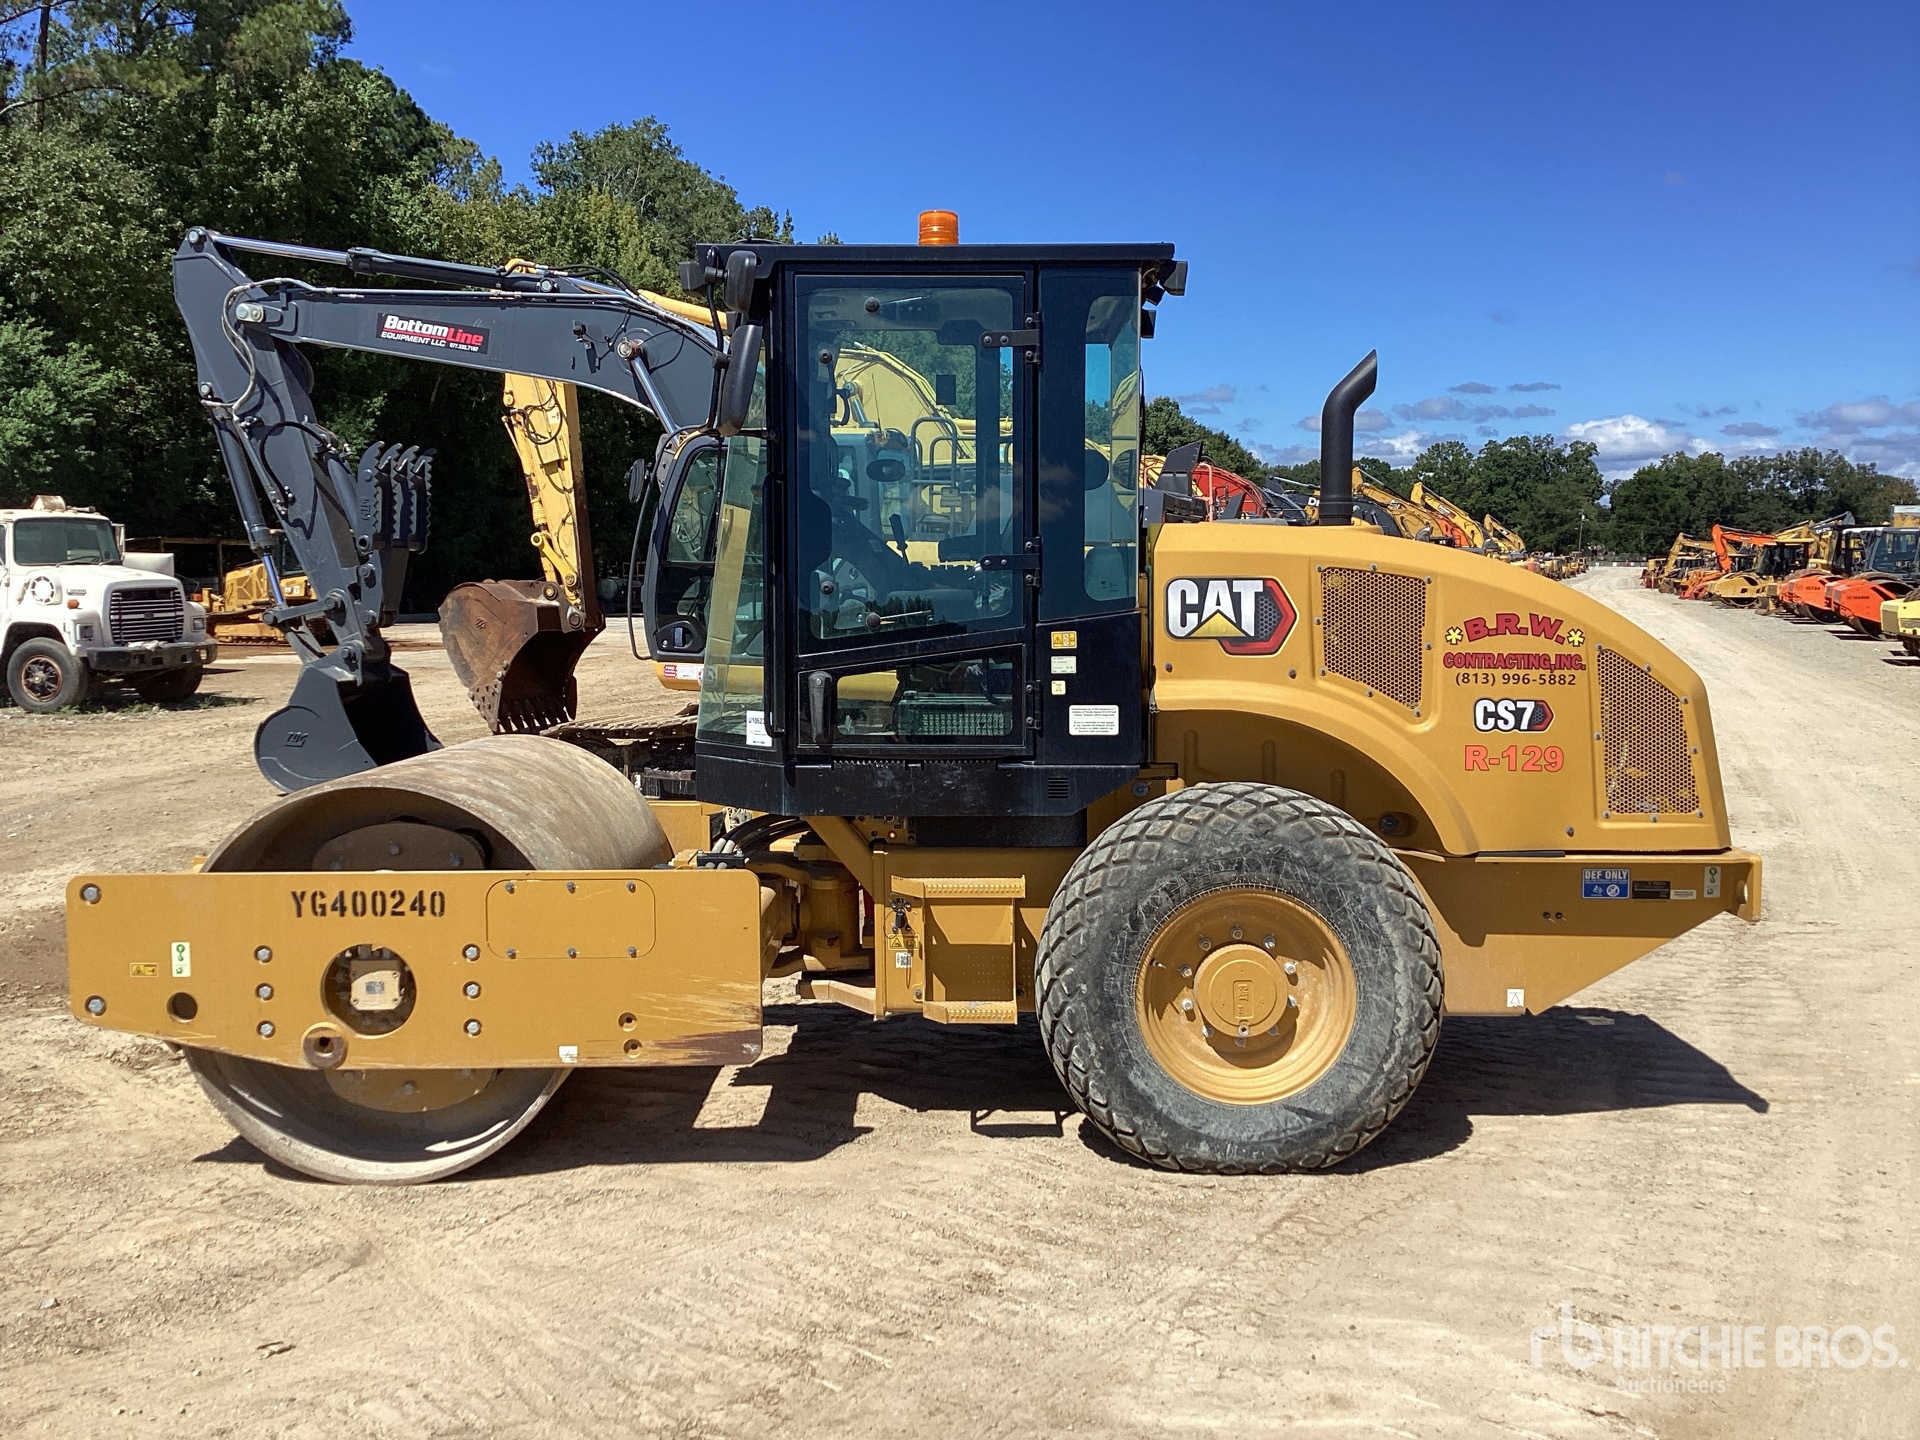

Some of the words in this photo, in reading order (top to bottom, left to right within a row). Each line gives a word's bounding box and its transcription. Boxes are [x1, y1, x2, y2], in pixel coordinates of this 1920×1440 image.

[381, 331, 430, 346] EQUIPMENT
[430, 339, 446, 348] LLC
[1167, 579, 1264, 638] CAT
[1463, 612, 1566, 645] B.R.W.
[1455, 672, 1496, 686] (813)
[1502, 673, 1577, 686] 996-5882
[1475, 699, 1535, 730] CS7
[1464, 744, 1565, 773] R-129
[1584, 870, 1602, 880] DEF
[1605, 870, 1628, 880] ONLY
[290, 889, 446, 918] YG400240
